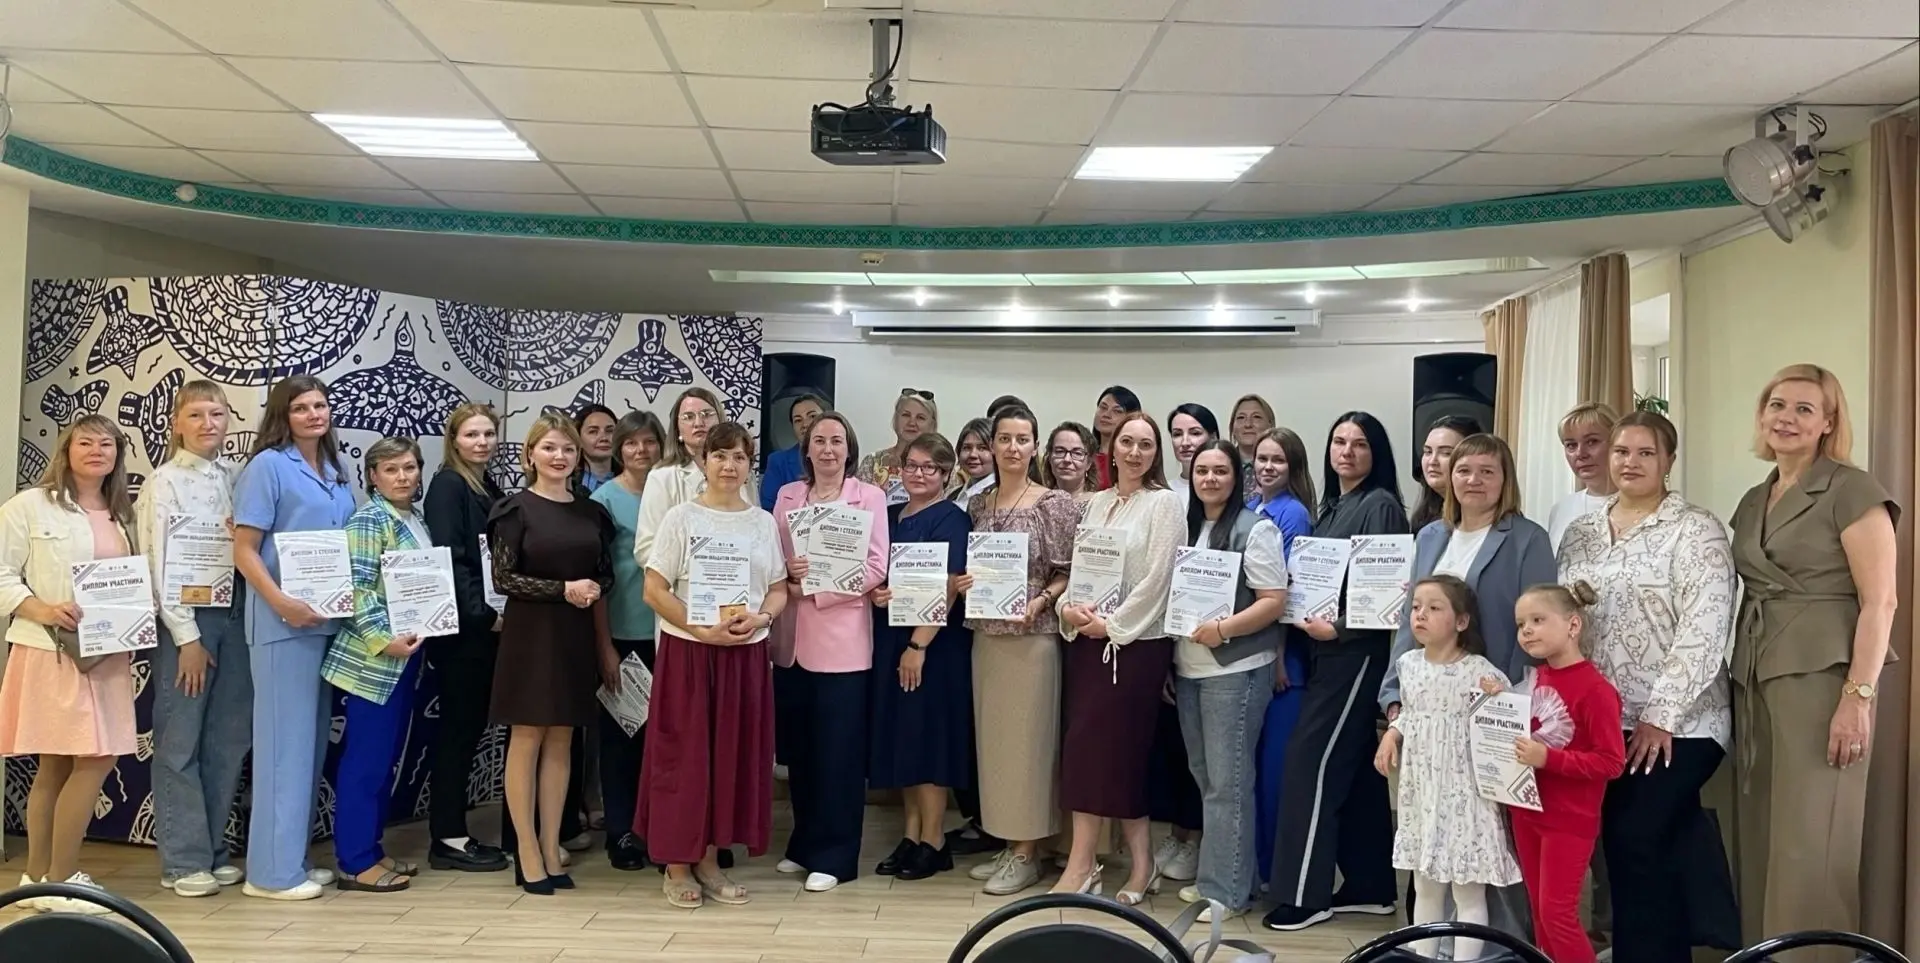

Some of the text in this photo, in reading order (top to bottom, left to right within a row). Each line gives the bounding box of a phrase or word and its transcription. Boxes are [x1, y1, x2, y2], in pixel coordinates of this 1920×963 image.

[820, 524, 839, 532] ДИПЛОМ
[843, 527, 863, 536] СТЕПЕНИ
[1078, 546, 1120, 557] ДИПЛОМ УЧАСТНИКА
[1321, 557, 1340, 565] СТЕПЕНИ
[1377, 556, 1405, 564] УЧАСТНИКА
[1180, 566, 1232, 578] ДИПЛОМ УЧАСТНИКА
[81, 577, 144, 591] ДИПЛОМ УЧАСТНИКА
[1475, 715, 1524, 731] ДИПЛОМ УЧАСТНИКА
